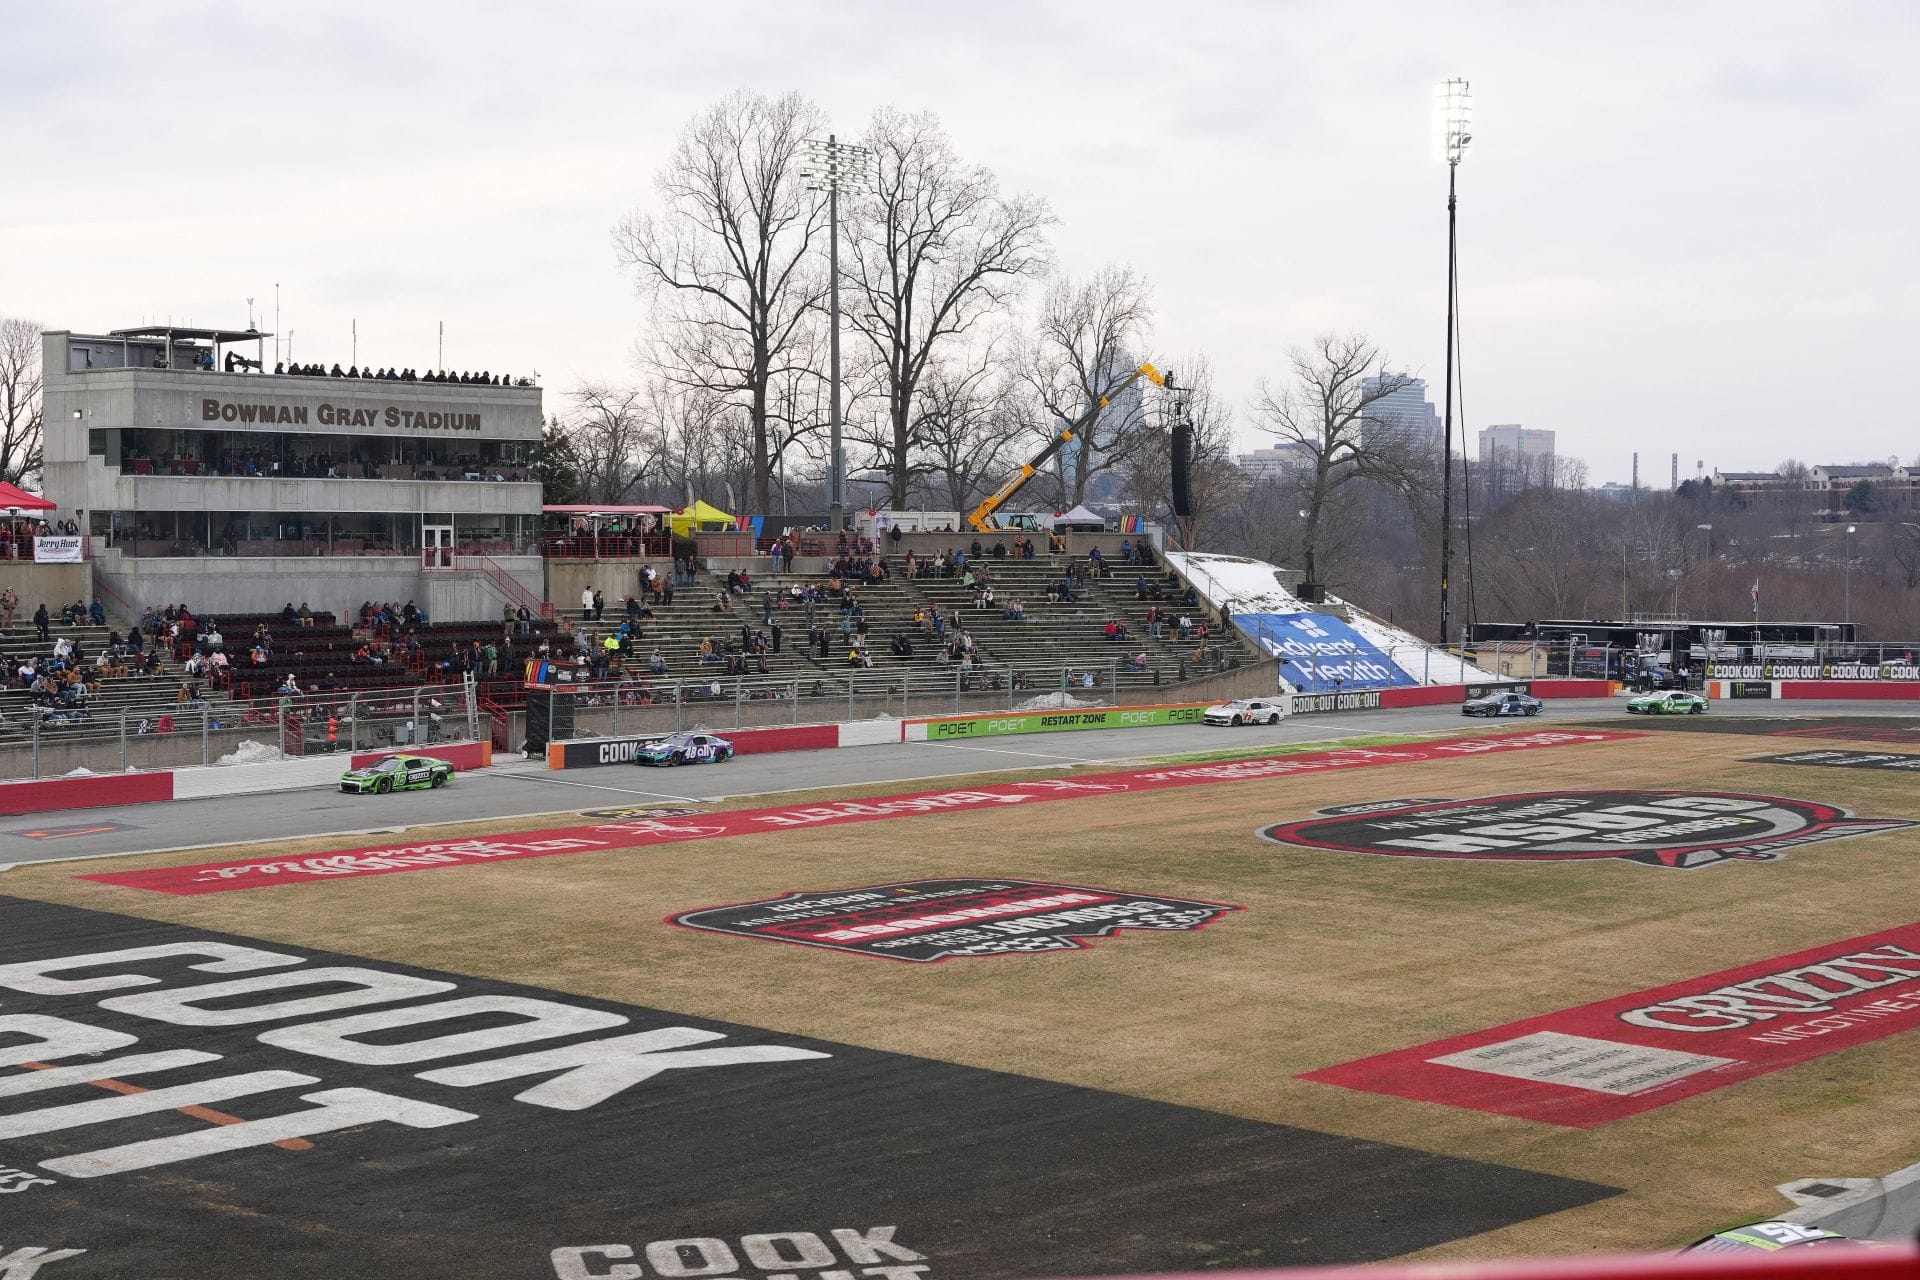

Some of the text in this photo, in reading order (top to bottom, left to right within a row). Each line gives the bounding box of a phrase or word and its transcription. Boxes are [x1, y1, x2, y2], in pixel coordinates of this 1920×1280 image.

[38, 539, 80, 549] Jerry Hunt
[1261, 637, 1368, 656] Advent
[1290, 659, 1397, 681] Health
[1714, 665, 1762, 678] COOK OUT
[1772, 665, 1820, 679] COOK OUT
[1831, 665, 1880, 679] COOK OUT
[1890, 666, 1920, 679] COOK
[1293, 695, 1336, 713] COOK OUT
[1337, 692, 1381, 710] COOK OUT
[1500, 703, 1511, 713] 2
[1662, 701, 1675, 711] 42
[1041, 713, 1107, 727] RESTART ZONE
[1120, 711, 1156, 723] POET
[1168, 708, 1201, 721] POET
[938, 721, 976, 736] POET
[988, 718, 1027, 732] POET
[599, 742, 639, 763] COOK
[684, 746, 697, 758] 48
[697, 744, 715, 758] ally
[393, 771, 407, 787] 16
[1370, 796, 1771, 853] CLASH
[764, 893, 886, 912] NASCAR
[814, 893, 1100, 941] MADHOUSE
[977, 904, 1154, 934] COOK OUT
[1617, 944, 1920, 1033] GRIZZLY
[0, 941, 833, 1111] COOK
[1748, 998, 1906, 1045] NICOTINE
[549, 1225, 930, 1280] COOK
